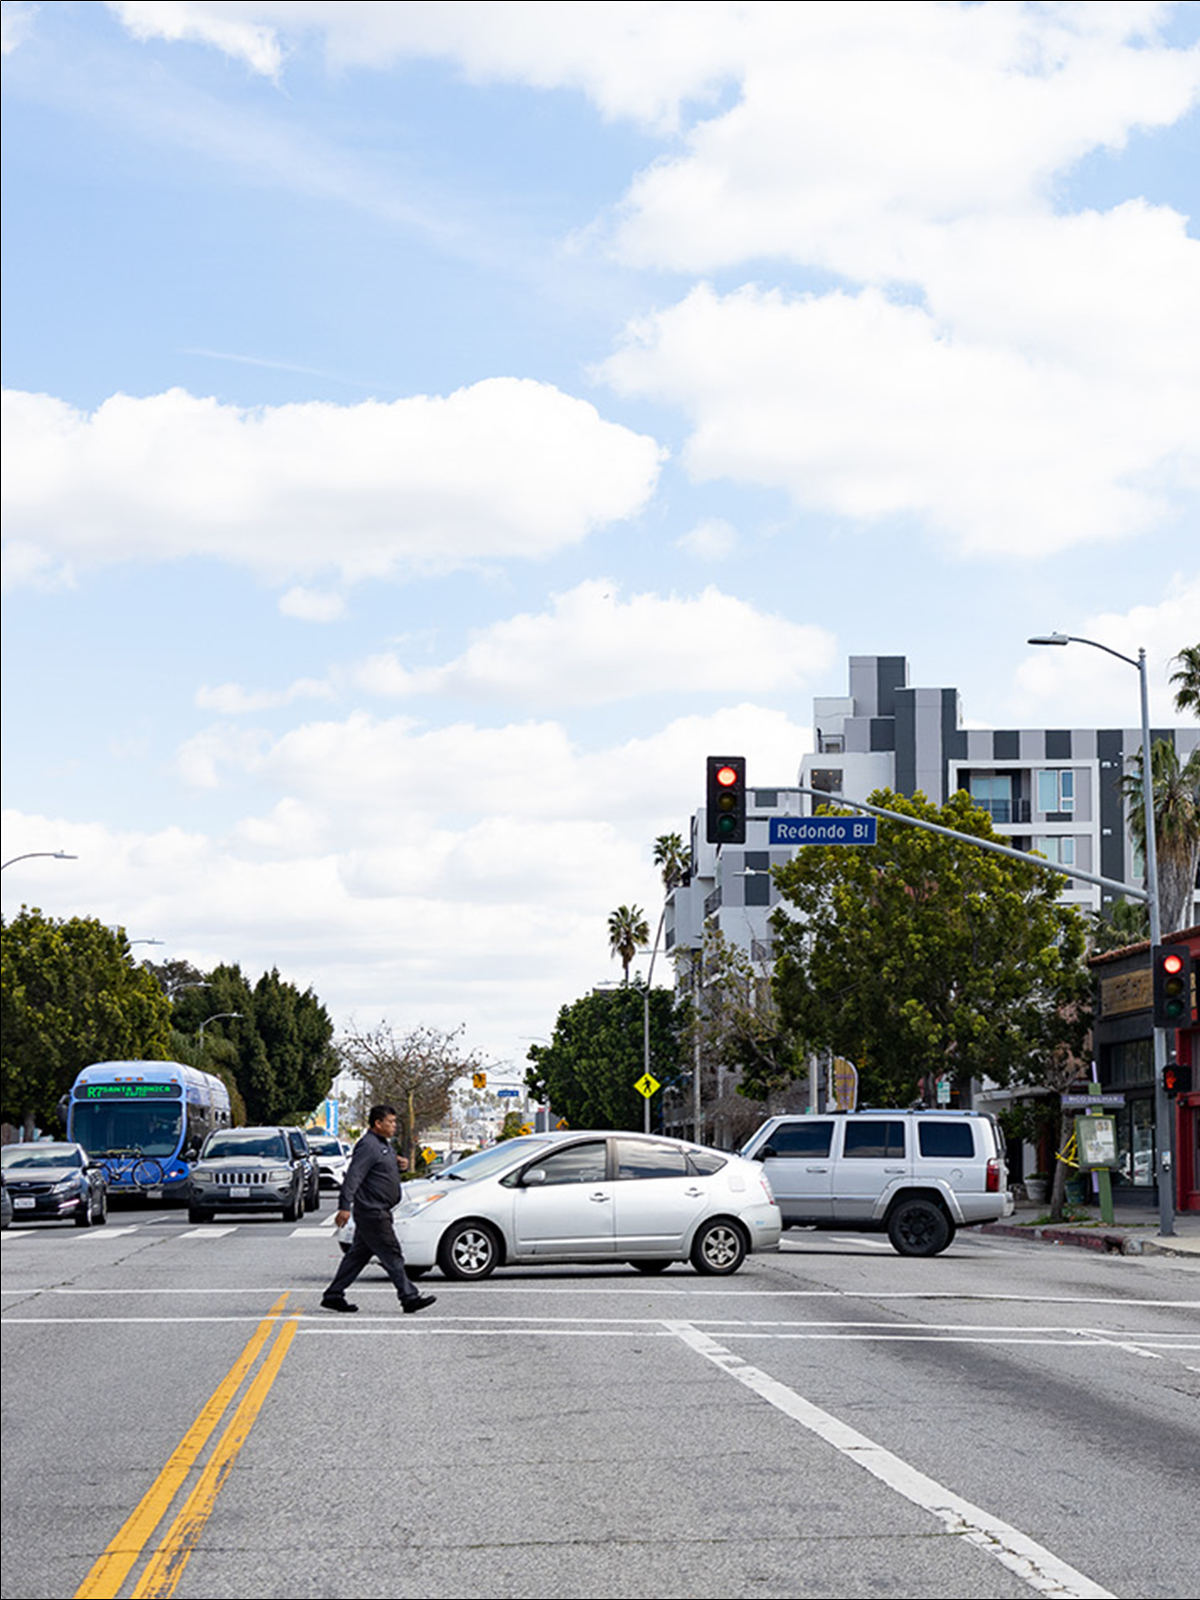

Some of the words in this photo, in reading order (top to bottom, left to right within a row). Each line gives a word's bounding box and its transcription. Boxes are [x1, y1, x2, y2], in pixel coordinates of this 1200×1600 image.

[777, 824, 846, 839] Redondo
[853, 824, 868, 838] Bl
[87, 1087, 102, 1098] R7
